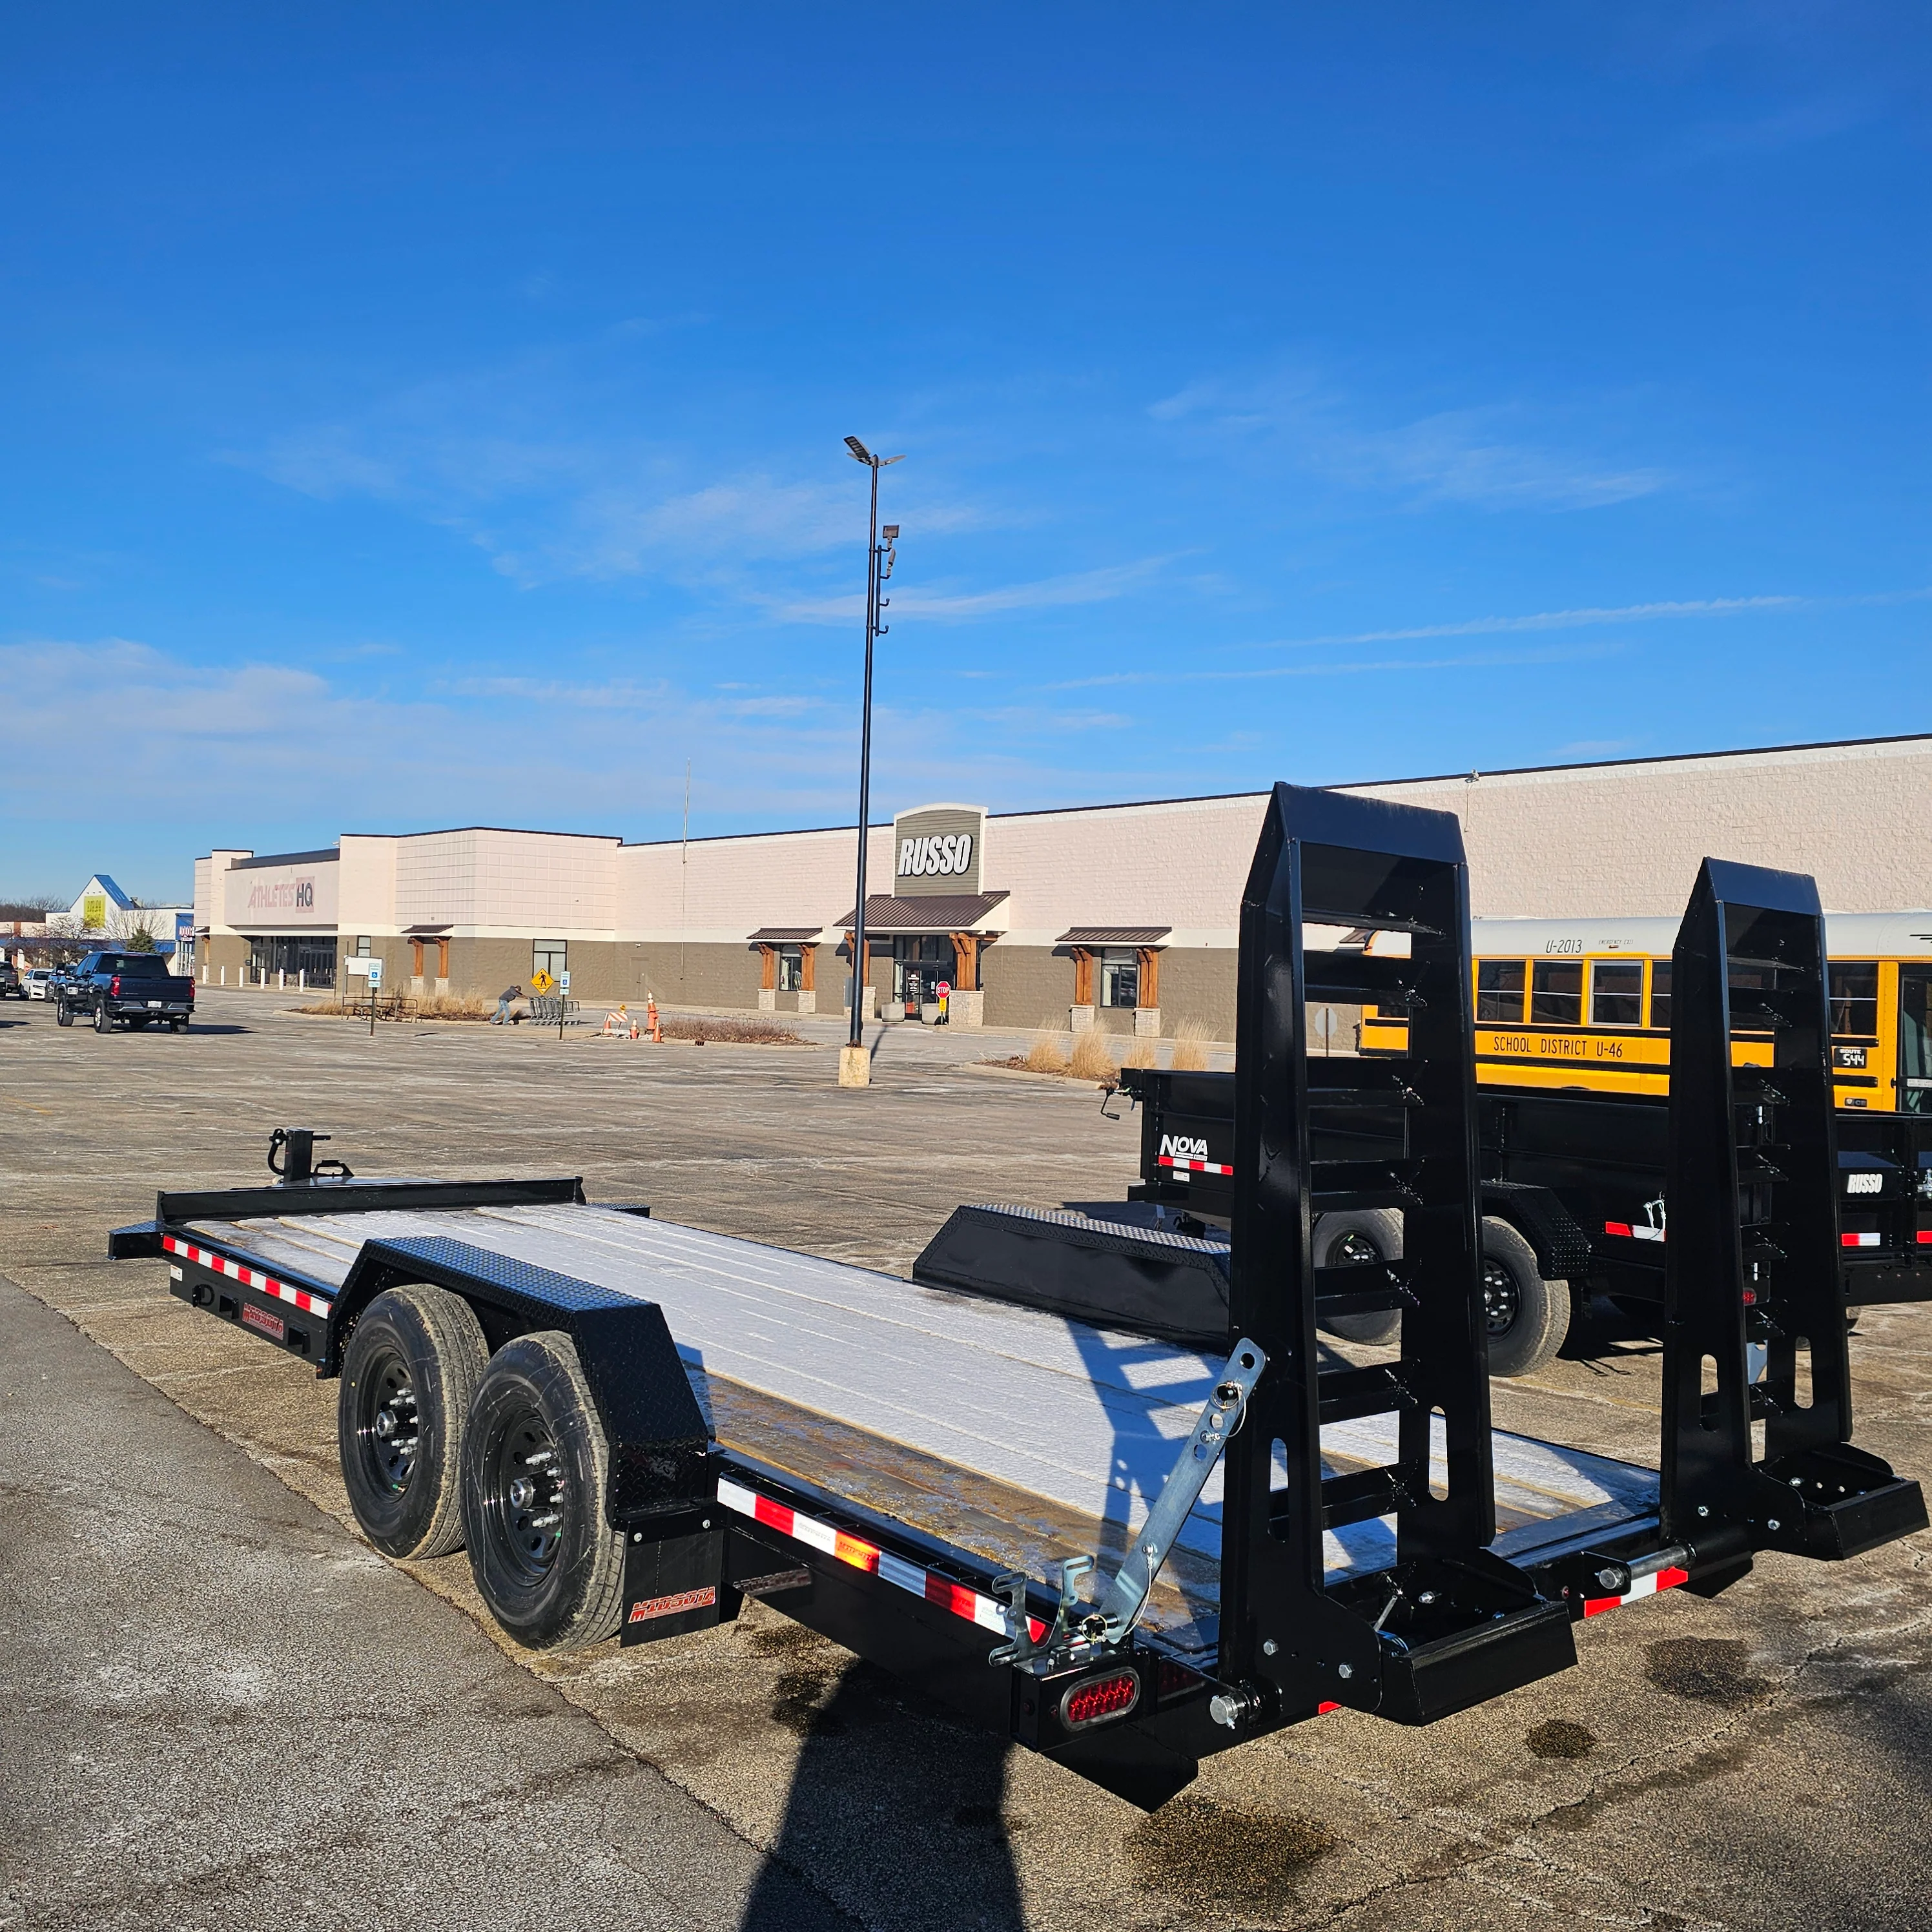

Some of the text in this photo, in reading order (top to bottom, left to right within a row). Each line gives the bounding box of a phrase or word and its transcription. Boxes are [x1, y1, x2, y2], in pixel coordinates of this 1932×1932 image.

[898, 834, 973, 877] RUSSO
[248, 883, 313, 908] ATHLETES HQ
[1546, 940, 1582, 953] U-2013
[1494, 1036, 1623, 1058] SCHOOL DISTRICT U-46
[1842, 1054, 1865, 1066] 544
[1160, 1134, 1208, 1157] NOVA
[1847, 1173, 1883, 1193] RUSSO
[242, 1302, 284, 1336] MIDSOTA
[628, 1586, 715, 1623] MIDSOTA
